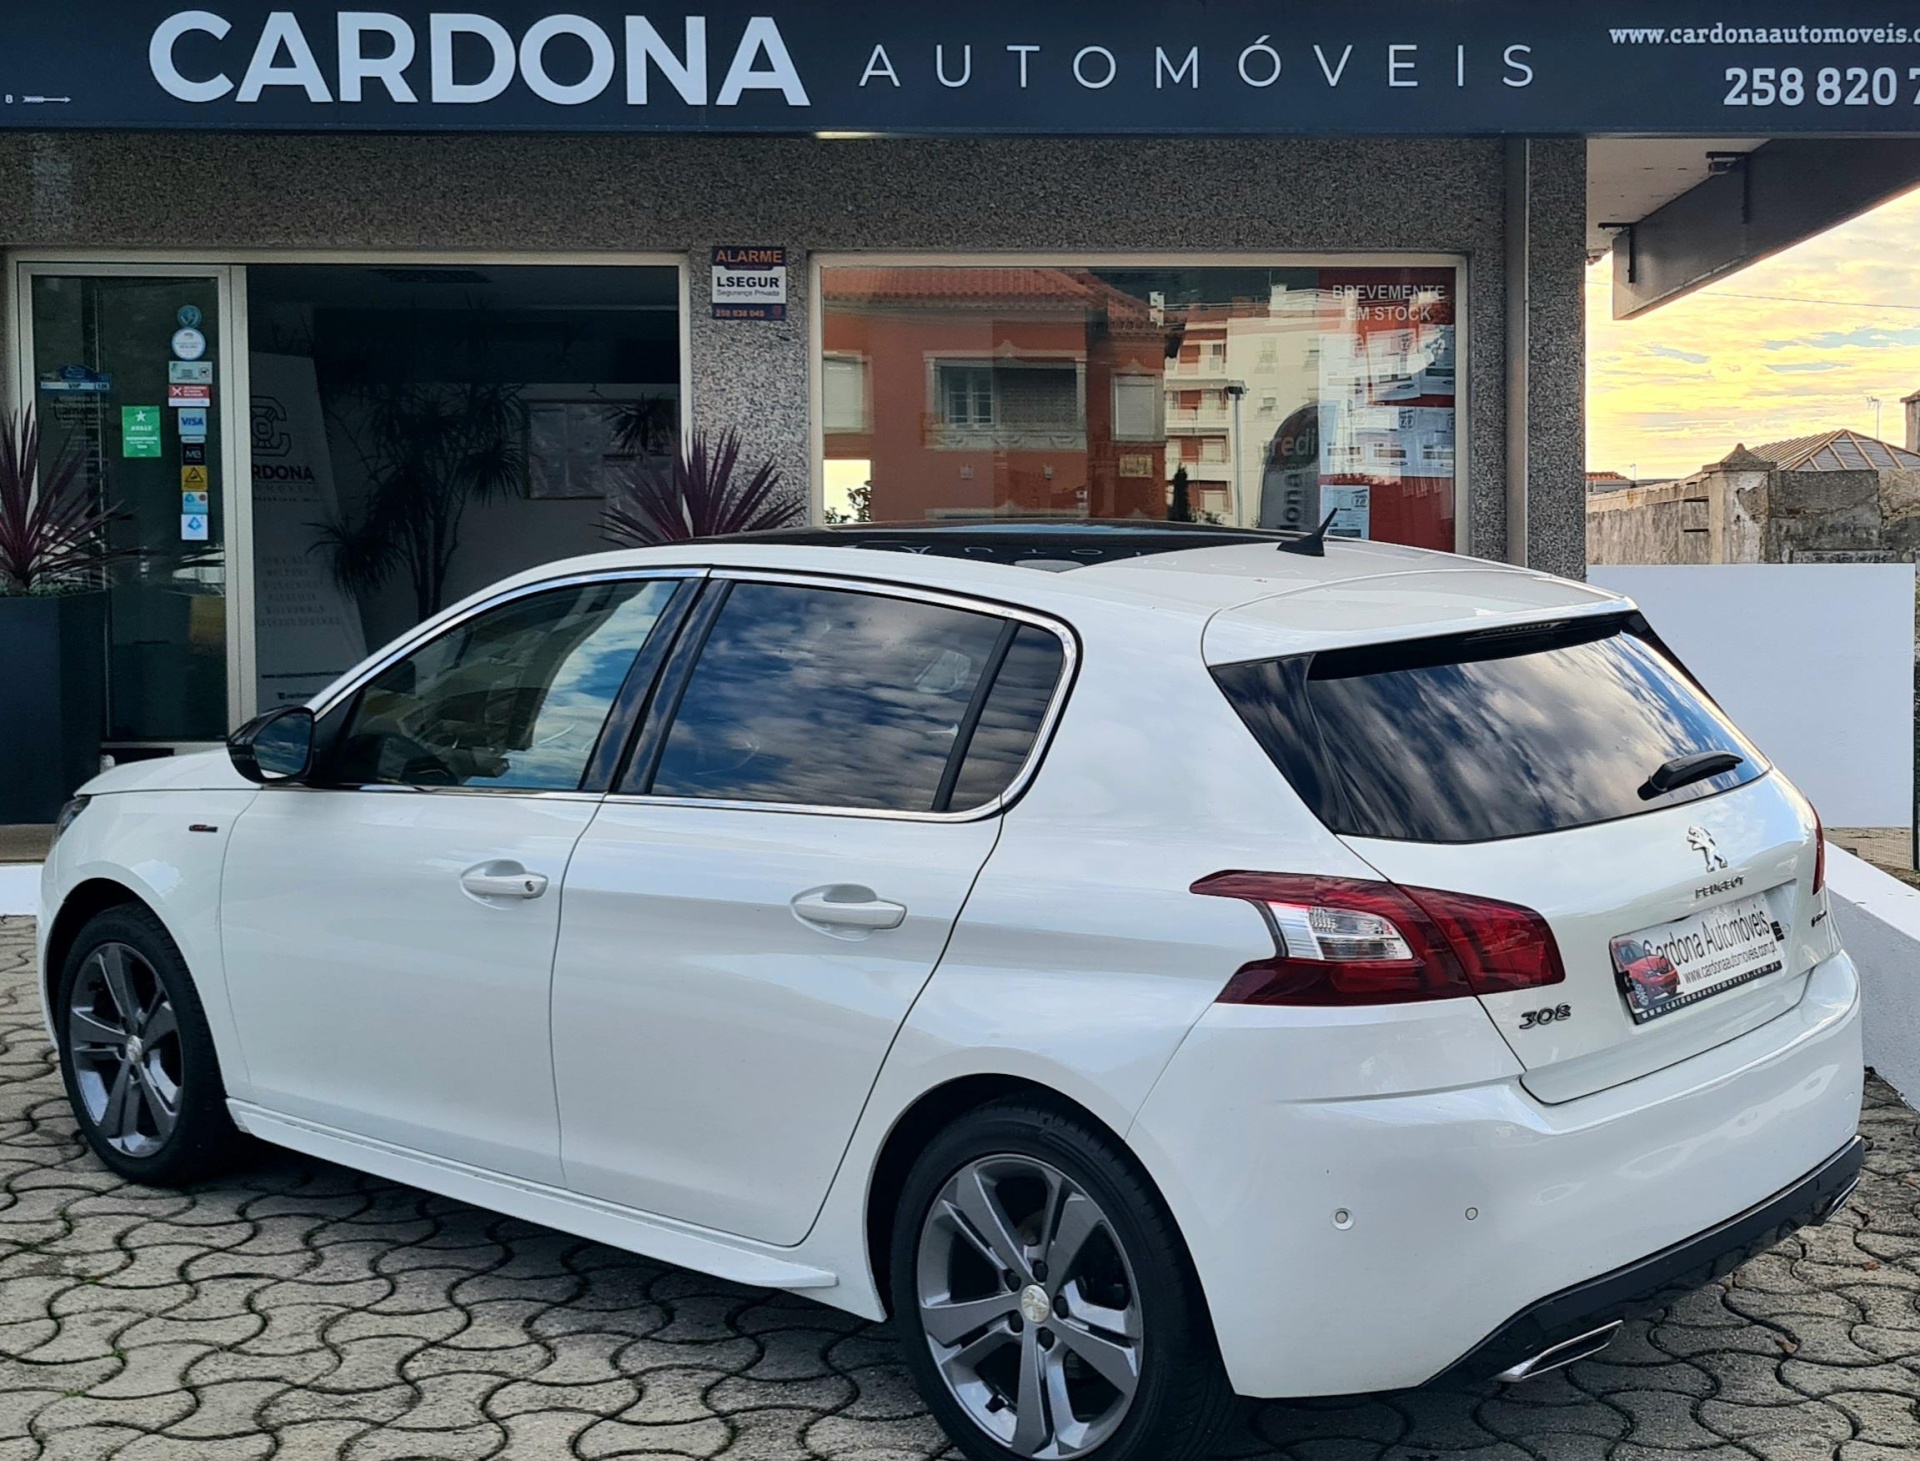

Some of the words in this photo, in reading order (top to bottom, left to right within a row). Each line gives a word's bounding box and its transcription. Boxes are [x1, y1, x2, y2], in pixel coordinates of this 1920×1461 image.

[148, 10, 812, 107] CARDONA
[858, 34, 1535, 90] AUTOMÓVEIS
[1723, 66, 1805, 106] 258
[1815, 66, 1898, 106] 820
[715, 249, 783, 264] ALARME
[716, 276, 780, 289] LSEGUR
[1332, 284, 1447, 300] BREVEMENTE
[1346, 307, 1371, 322] EM
[1374, 306, 1432, 322] STOCK
[181, 416, 204, 427] VISA
[251, 464, 316, 481] RDONA
[1519, 1002, 1572, 1030] 308
